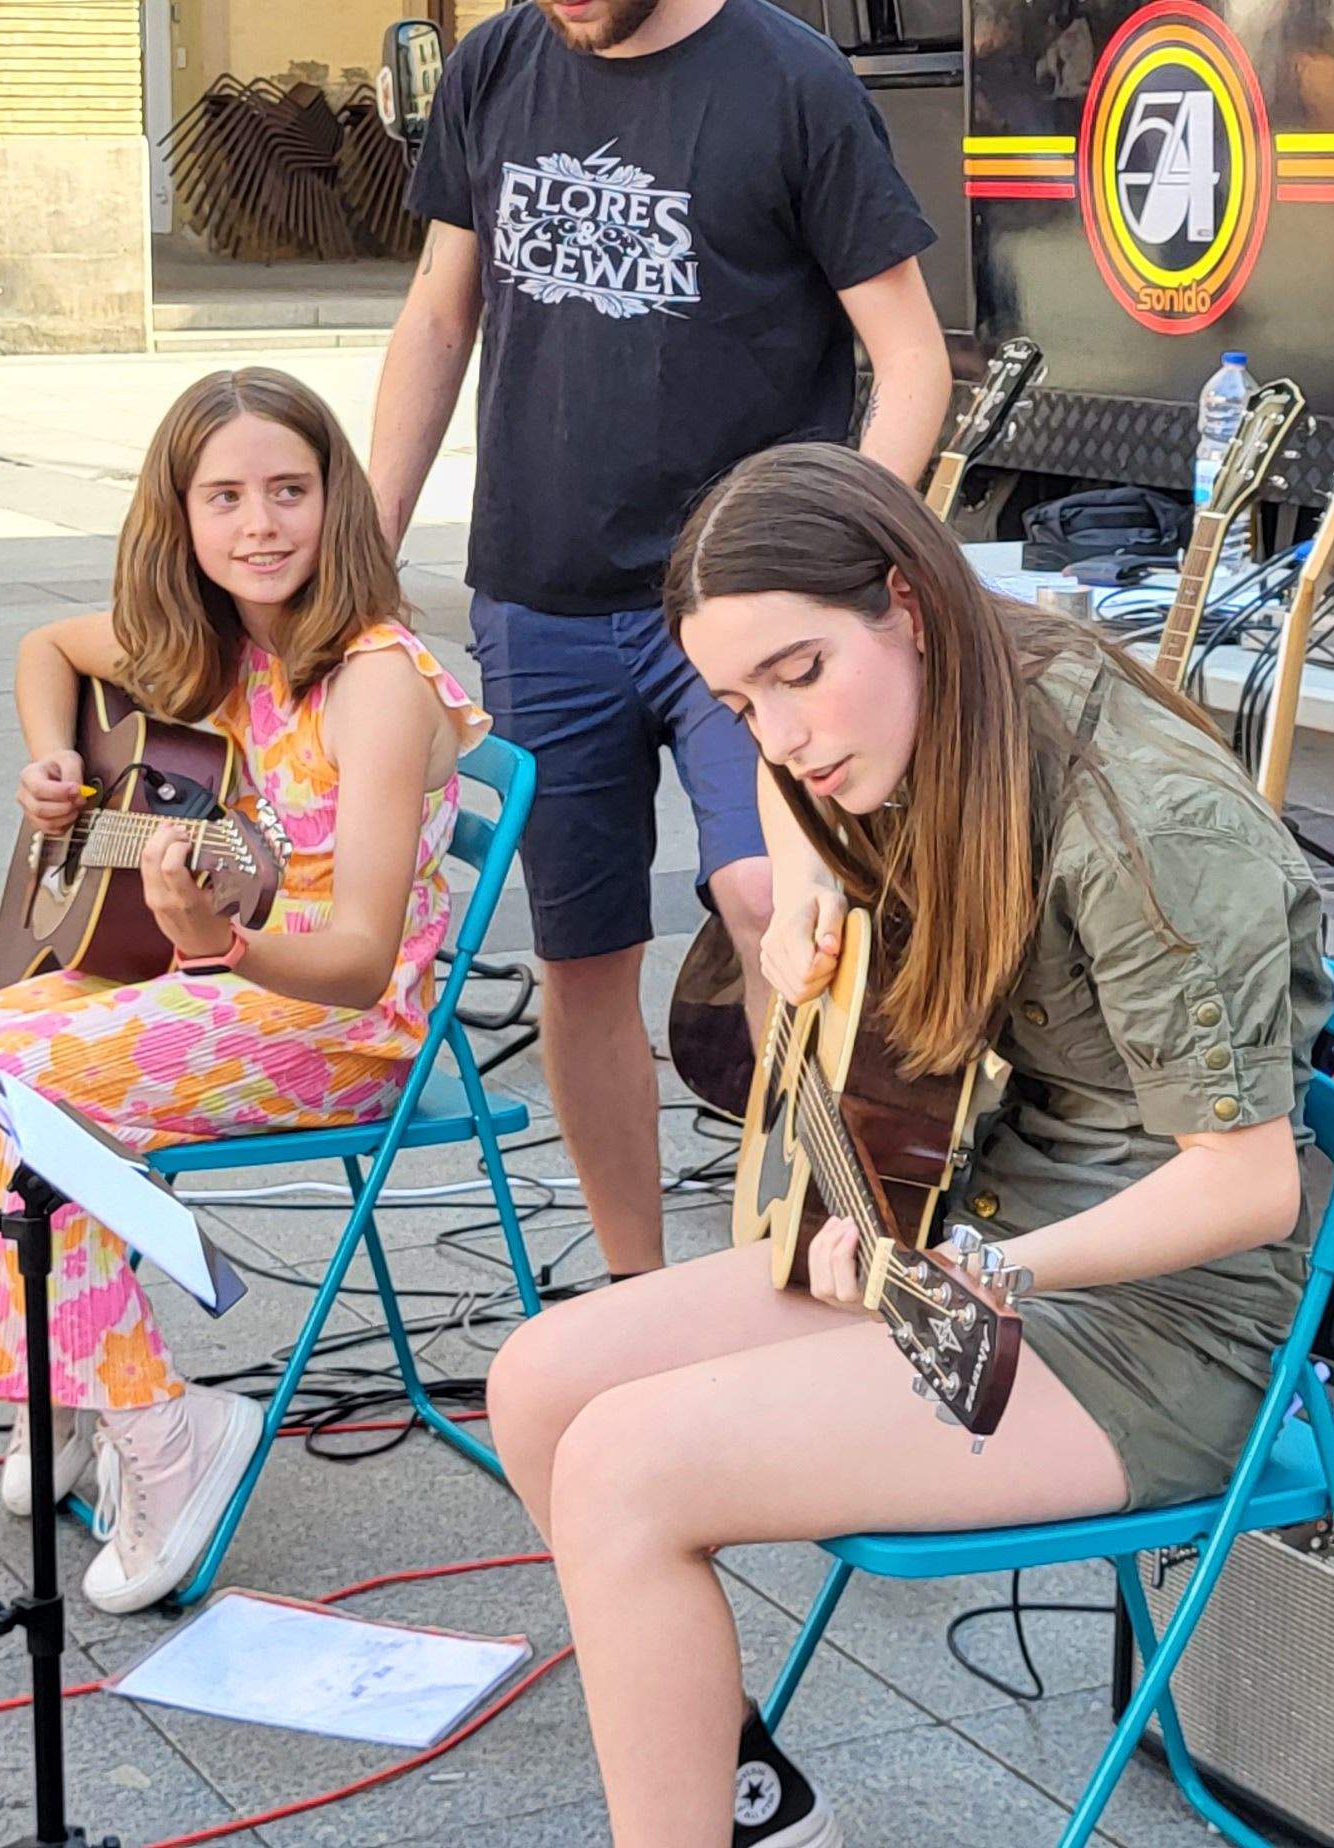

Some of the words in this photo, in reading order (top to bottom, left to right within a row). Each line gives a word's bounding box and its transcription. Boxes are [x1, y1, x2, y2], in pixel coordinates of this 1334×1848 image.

[498, 172, 693, 252] FLORES
[577, 218, 598, 246] &
[1136, 279, 1211, 313] sonido
